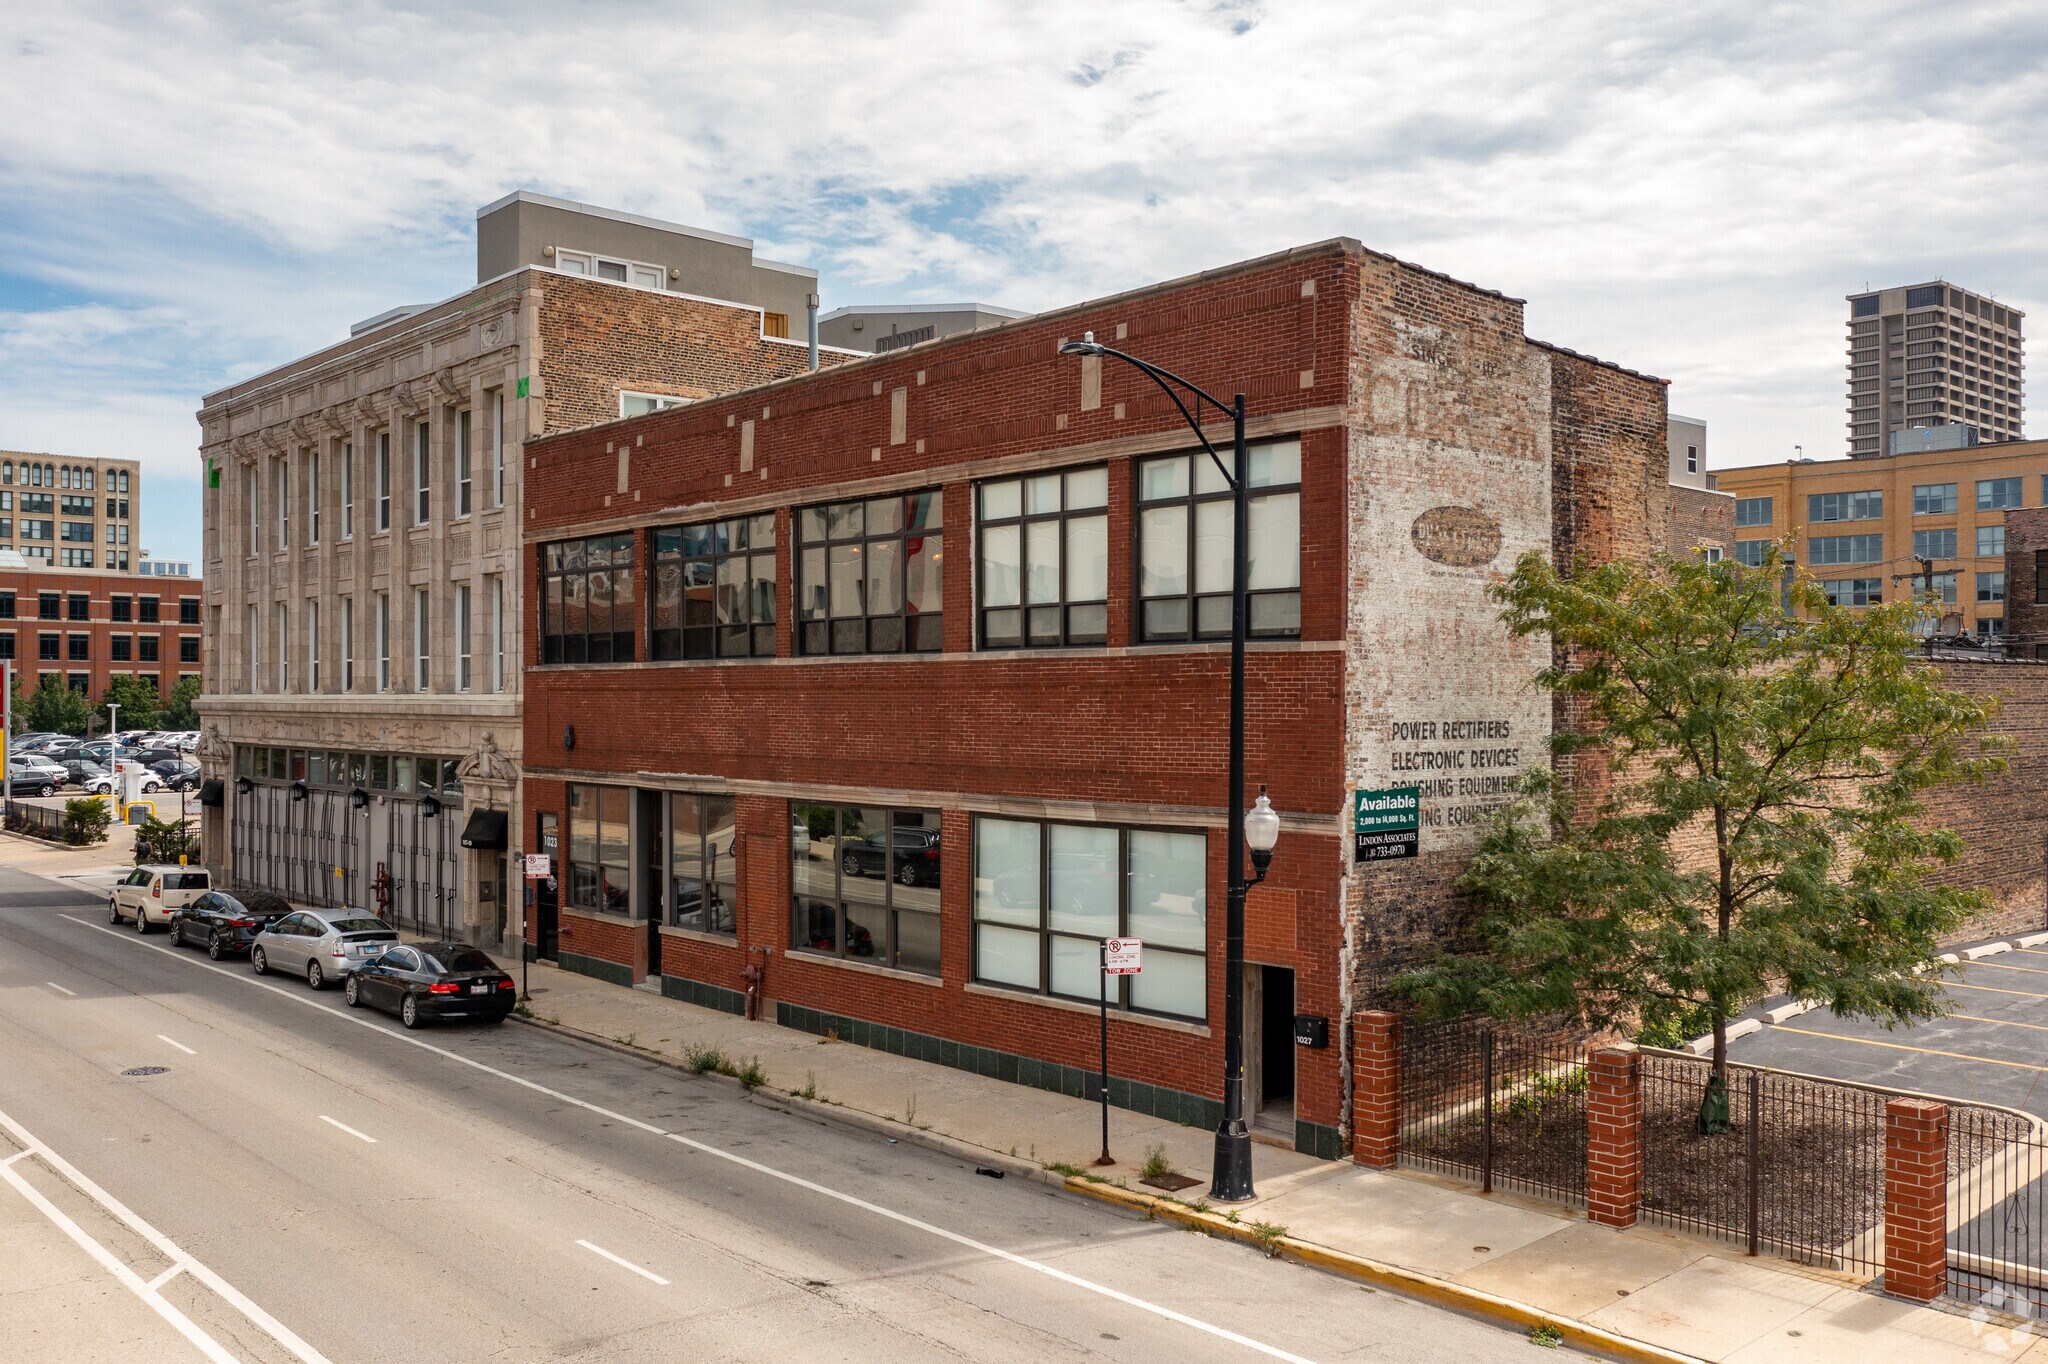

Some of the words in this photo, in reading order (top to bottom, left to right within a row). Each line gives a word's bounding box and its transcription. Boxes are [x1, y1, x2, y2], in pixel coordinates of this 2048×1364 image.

[1391, 721, 1437, 741] POWER
[1442, 720, 1511, 740] RECTIFIERS
[1391, 750, 1465, 771] ELECTRONIC
[1470, 748, 1519, 768] DEVICES
[1391, 778, 1453, 798] SHING
[1459, 775, 1521, 798] EQUIPMEN
[1359, 794, 1416, 811] Available
[1360, 817, 1375, 826] 2,000
[1399, 814, 1407, 823] Sq.
[544, 836, 557, 848] 1023
[1359, 835, 1383, 846] LINDON
[1383, 832, 1416, 843] ASSOCIATES
[1377, 845, 1405, 857] 733-0970
[1296, 1036, 1312, 1045] 1027
